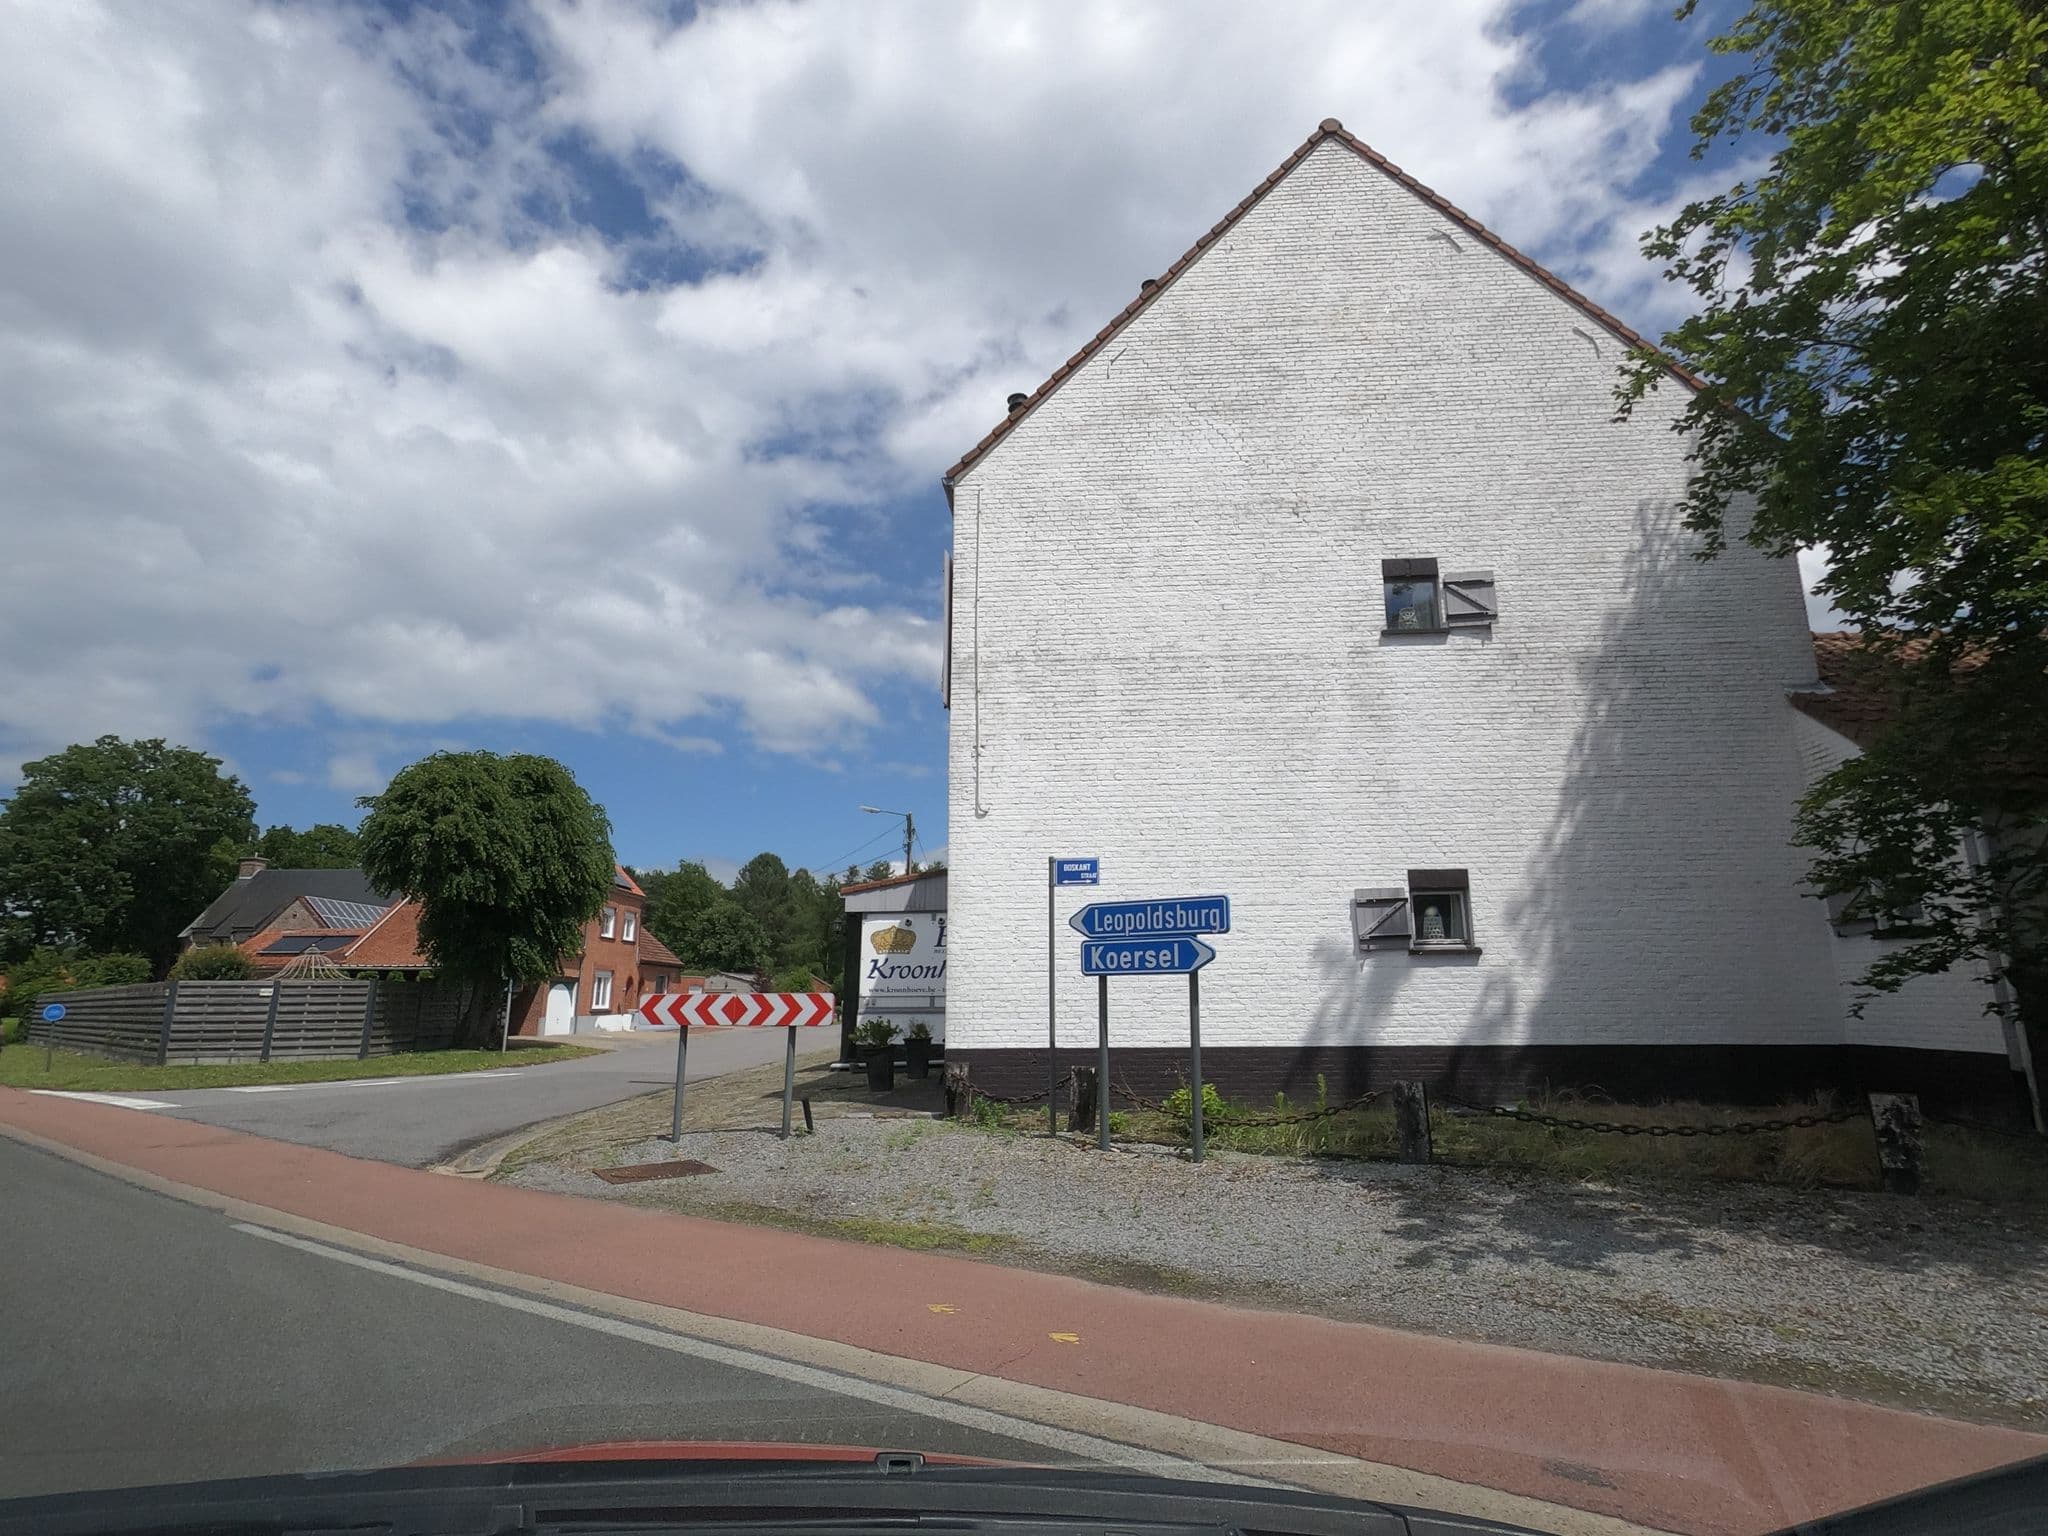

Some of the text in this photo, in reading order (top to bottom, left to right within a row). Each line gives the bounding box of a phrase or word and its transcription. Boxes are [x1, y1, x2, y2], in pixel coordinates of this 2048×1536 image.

[1063, 863, 1091, 872] BOSKANT
[1094, 904, 1220, 936] Leopoldsburg
[1091, 943, 1179, 970] Koersel
